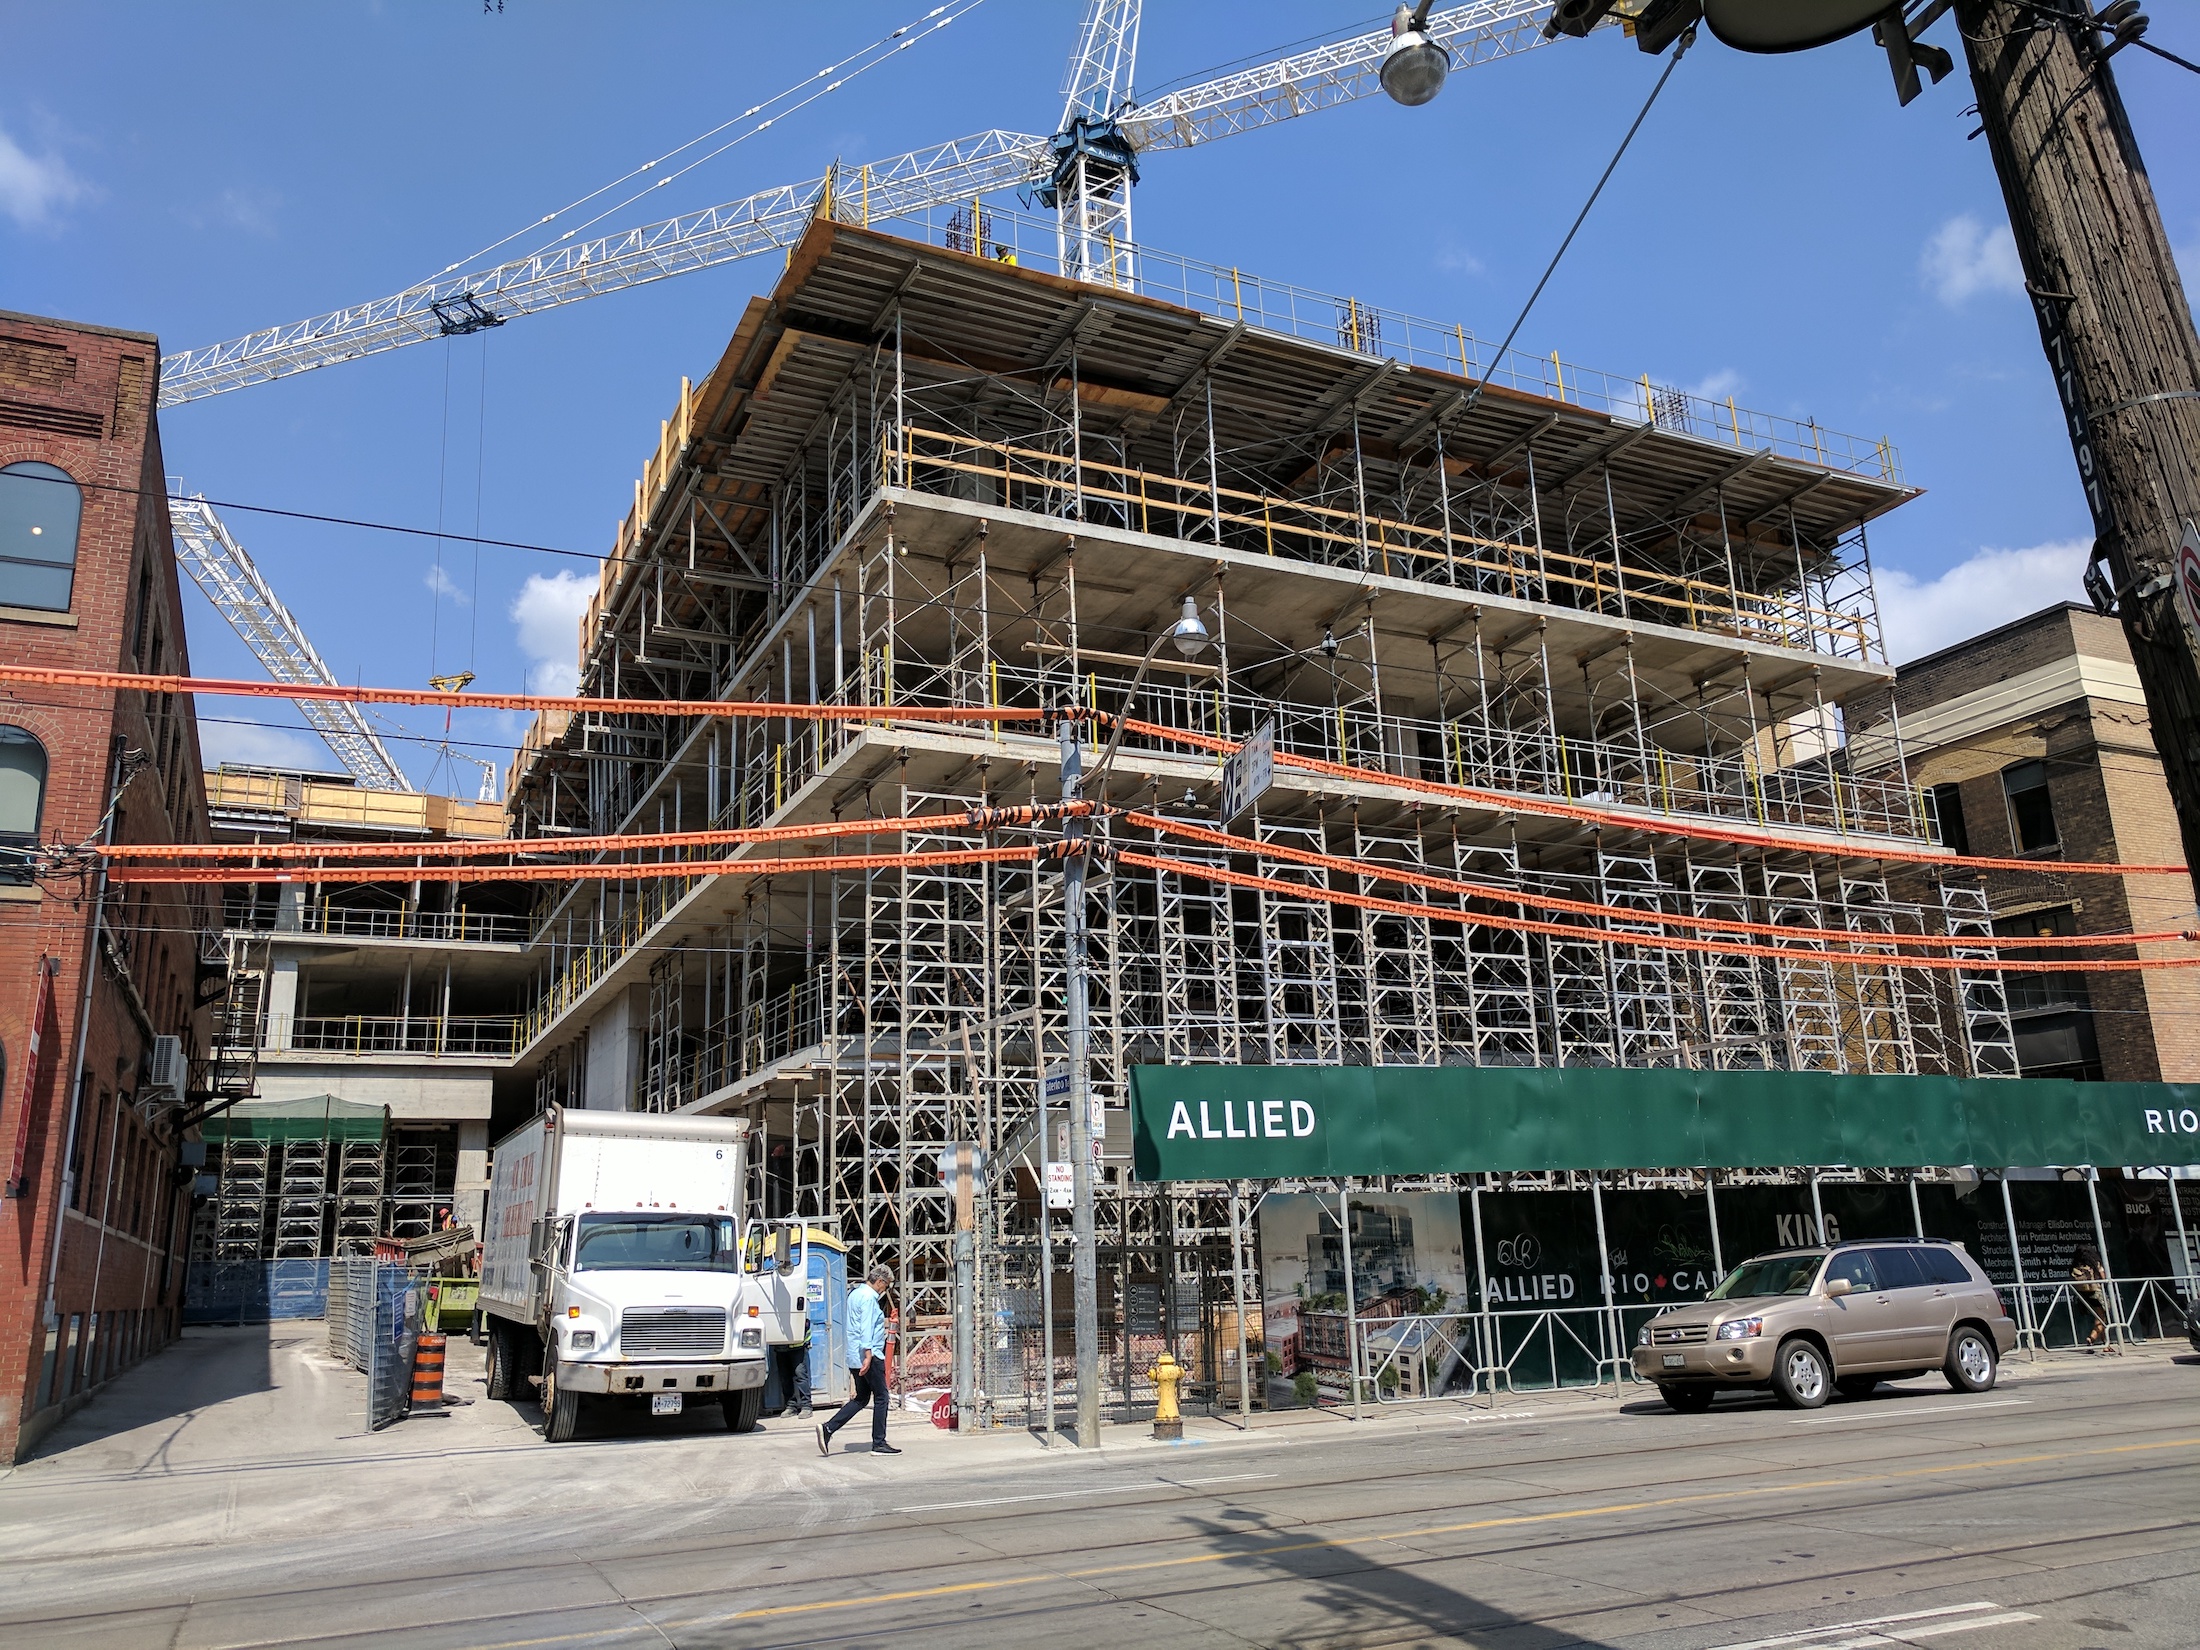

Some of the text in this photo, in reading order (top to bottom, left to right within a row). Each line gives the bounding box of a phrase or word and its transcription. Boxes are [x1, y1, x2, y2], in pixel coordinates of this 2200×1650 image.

[1046, 1079, 1064, 1092] aterloo
[1166, 1100, 1316, 1139] ALLIED
[2144, 1109, 2199, 1133] RIO
[716, 1149, 723, 1160] 6
[1055, 1165, 1064, 1173] NO
[1048, 1174, 1072, 1182] STANDING
[2125, 1203, 2152, 1215] BUCA
[1776, 1213, 1841, 1246] KING
[2020, 1220, 2047, 1231] Manager
[2047, 1220, 2073, 1229] EllisDon
[2074, 1219, 2111, 1230] Corpoion
[1980, 1233, 2008, 1242] Architect
[2059, 1232, 2092, 1241] Architects
[1981, 1244, 2013, 1255] Structura
[2016, 1244, 2031, 1254] ead
[2033, 1244, 2052, 1254] Jones
[1983, 1257, 2015, 1267] Mechanic
[2020, 1257, 2041, 1266] Smith
[2049, 1256, 2073, 1266] Anderse
[2021, 1269, 2040, 1280] ulvey
[2041, 1269, 2048, 1279] &
[2048, 1269, 2070, 1279] Banani
[1487, 1274, 1575, 1302] ALLIED
[933, 1404, 951, 1419] OP
